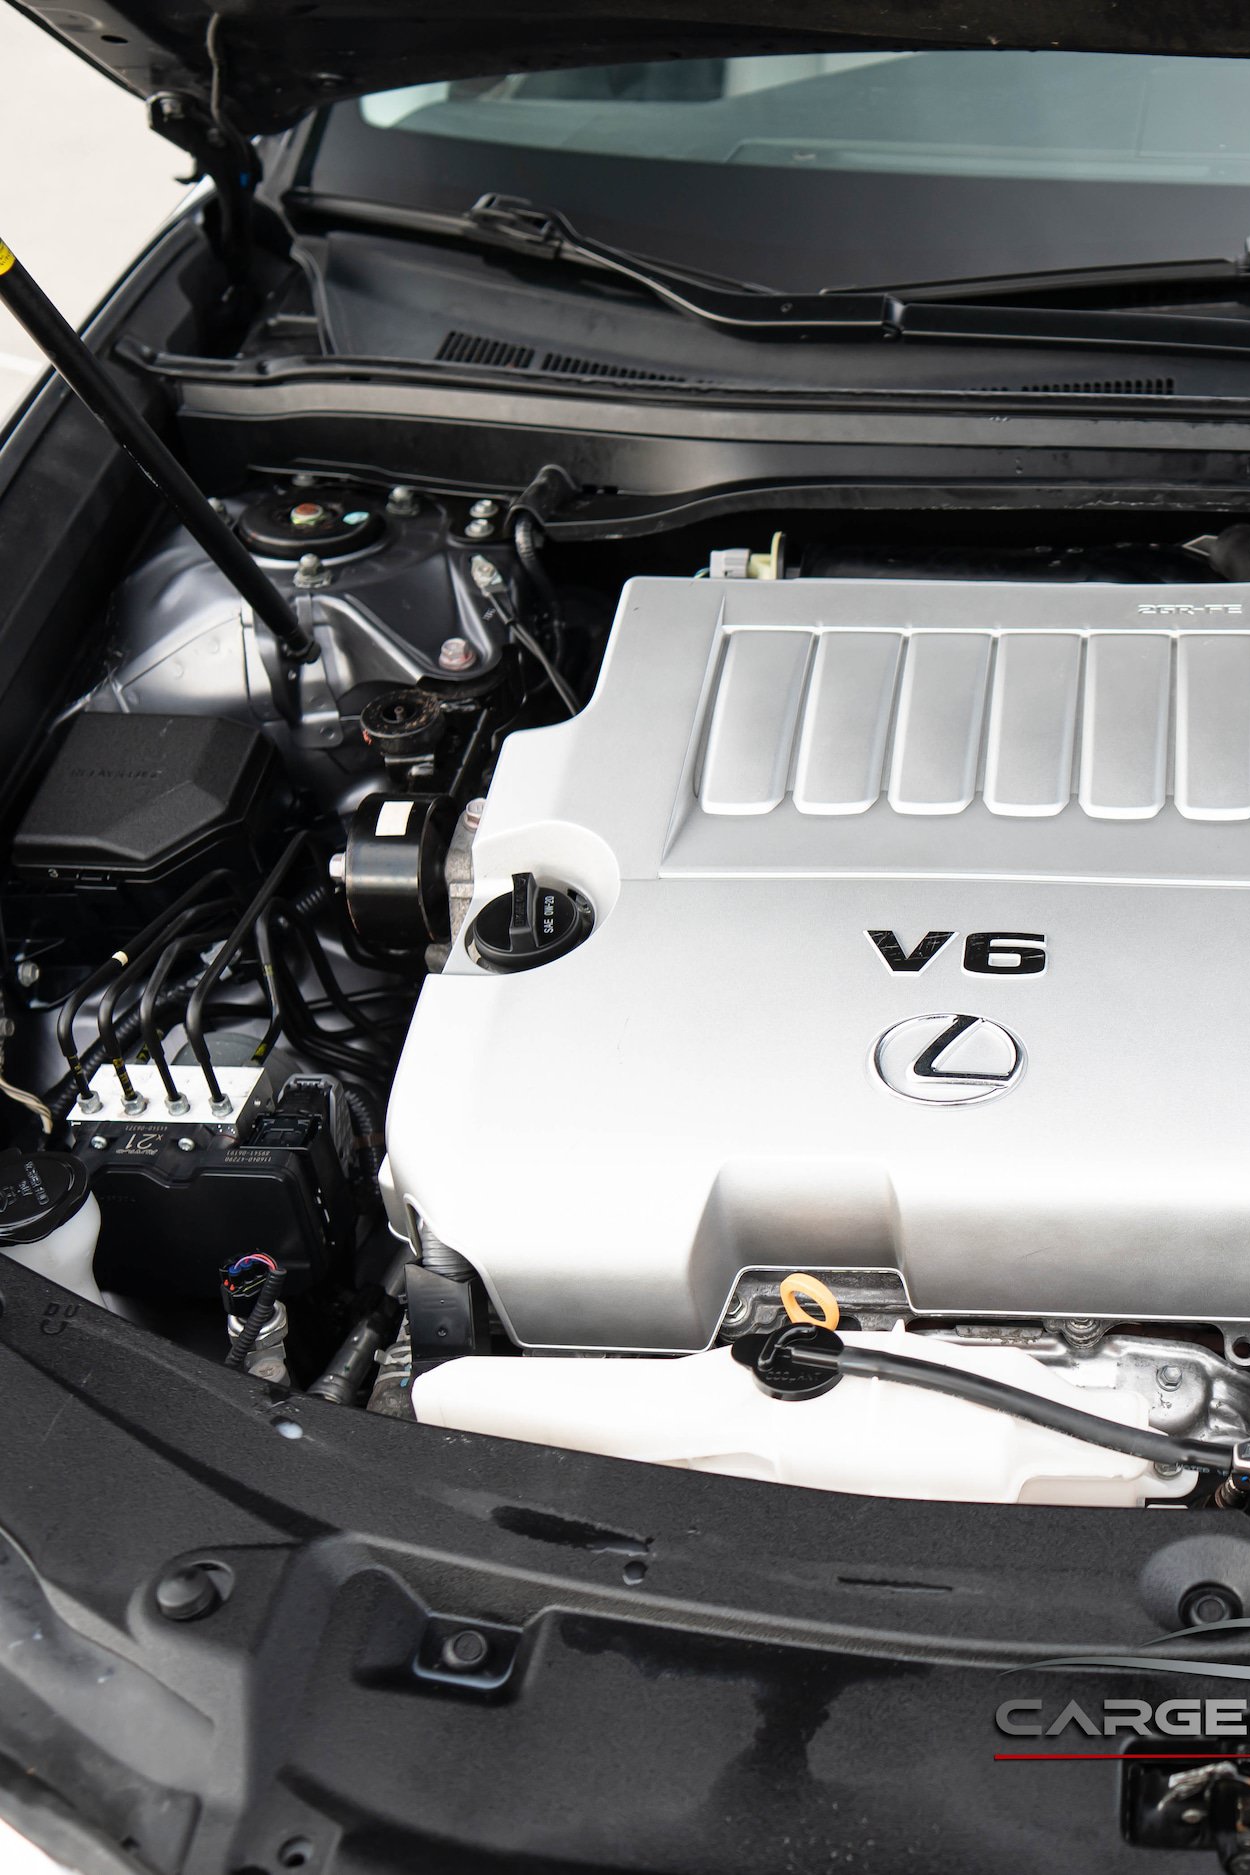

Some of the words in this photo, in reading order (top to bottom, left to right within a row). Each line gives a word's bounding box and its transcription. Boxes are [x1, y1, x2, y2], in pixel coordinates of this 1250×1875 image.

[1137, 604, 1243, 615] 2GR-FE
[543, 895, 555, 916] 0W-20
[543, 918, 554, 934] SAE
[863, 930, 1047, 977] V6
